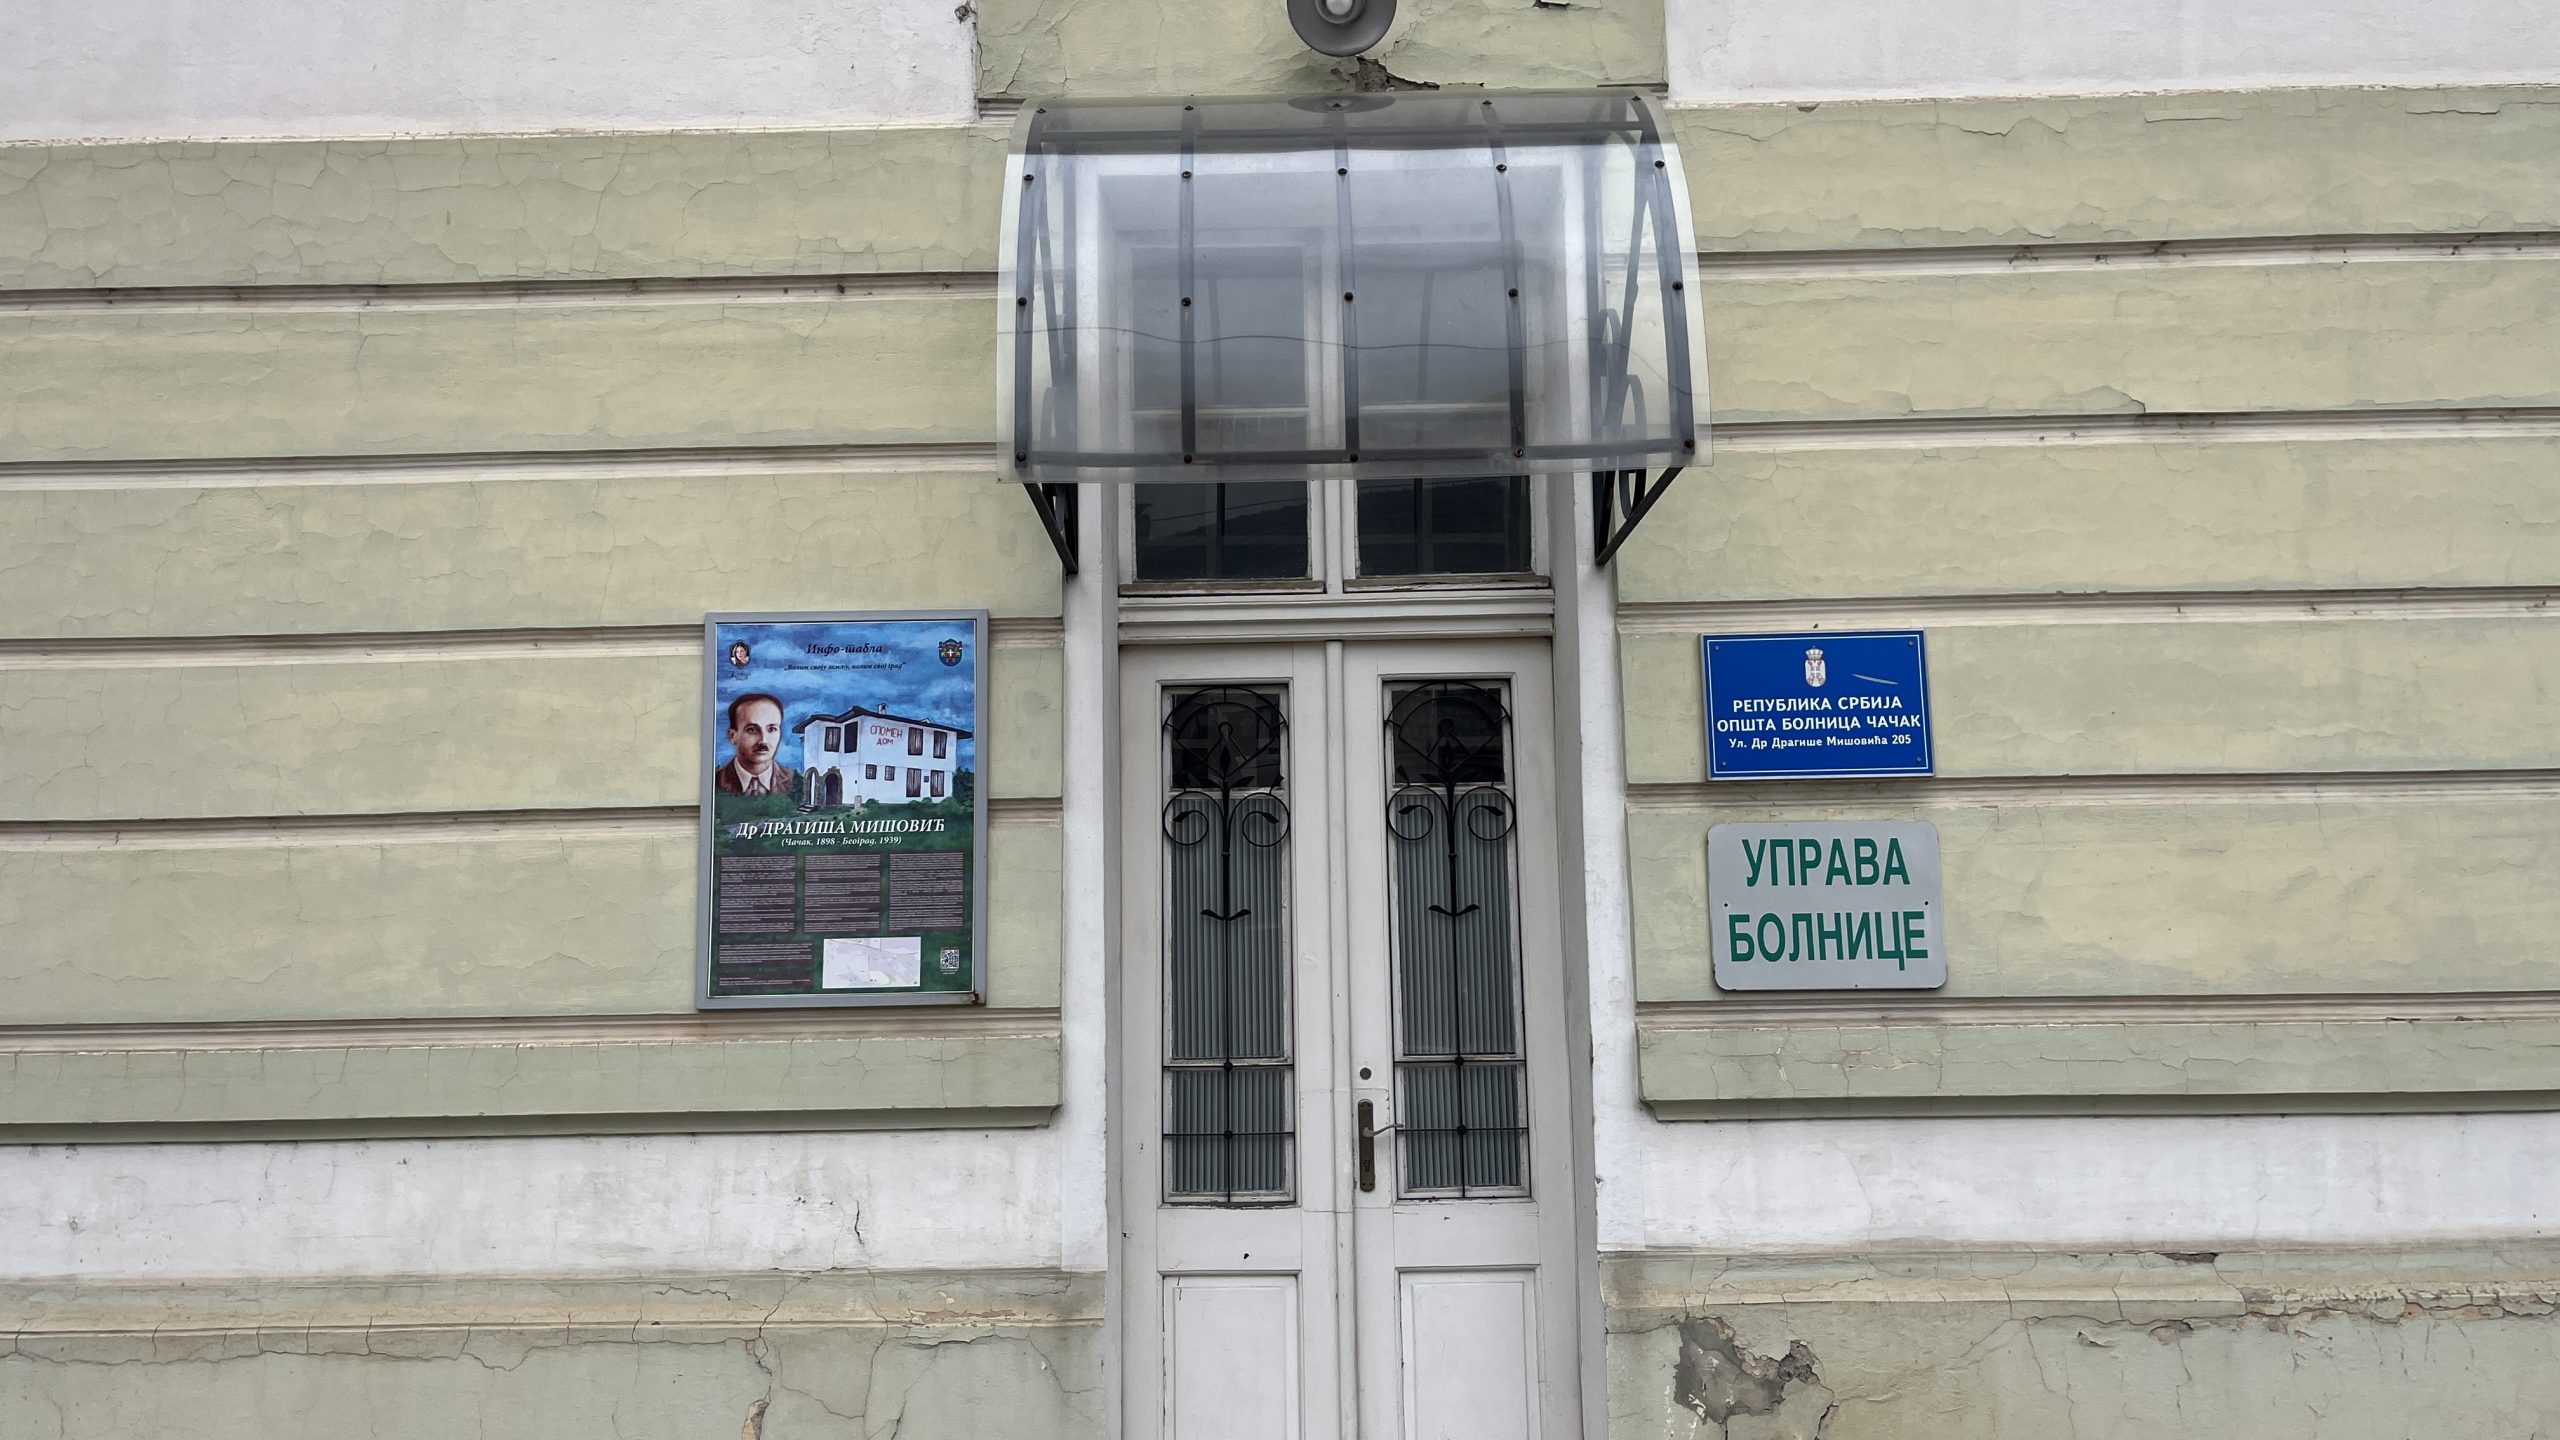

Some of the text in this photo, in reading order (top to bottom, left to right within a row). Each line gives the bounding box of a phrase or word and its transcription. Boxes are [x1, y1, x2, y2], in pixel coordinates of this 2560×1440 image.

[1732, 696, 1903, 713] РЕПУБЛИКА СРБИЈА
[870, 725, 902, 738] СПОМЕН
[1716, 714, 1921, 732] ОПШТА БОЛНИЦА ЧАЧАК
[876, 738, 893, 746] ДОМ
[1728, 734, 1911, 750] Ул. Др Драгише Мишовића 205
[736, 818, 945, 839] Др ДРАГИША МИШОВИЋ
[781, 838, 813, 847] (Чачак,
[879, 836, 902, 845] 1939)
[1741, 837, 1910, 887] УПРАВА
[1728, 911, 1929, 971] БОЛНИЦЕ
